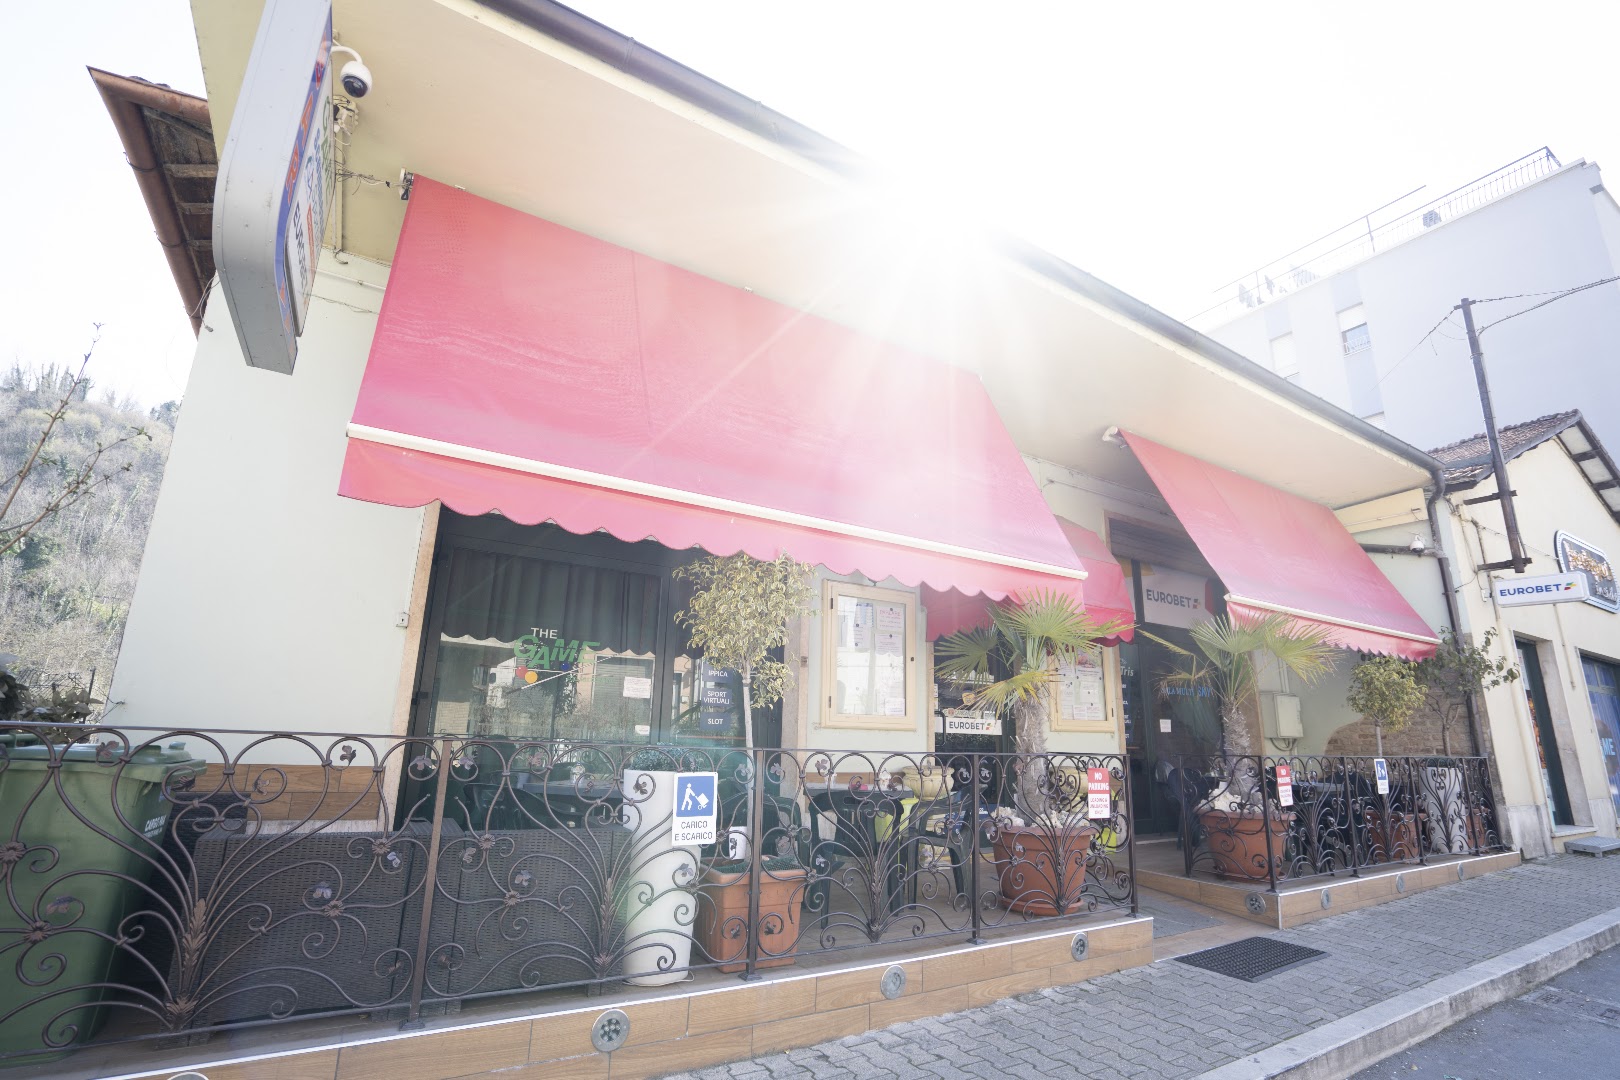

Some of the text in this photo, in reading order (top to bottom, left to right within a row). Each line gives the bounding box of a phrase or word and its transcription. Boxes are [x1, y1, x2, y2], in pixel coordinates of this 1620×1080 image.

[1499, 583, 1563, 597] EUROBET
[1146, 588, 1192, 609] EUROBET
[530, 627, 558, 639] THE
[513, 634, 601, 670] GAME
[708, 669, 728, 678] IPPICA
[707, 690, 727, 698] SPORT
[703, 697, 730, 705] VIRTUALI
[948, 721, 985, 731] EUROBET
[1094, 772, 1103, 781] NO
[1088, 782, 1109, 791] PARKING
[680, 820, 708, 830] CARICO
[674, 831, 713, 841] E SCARICO
